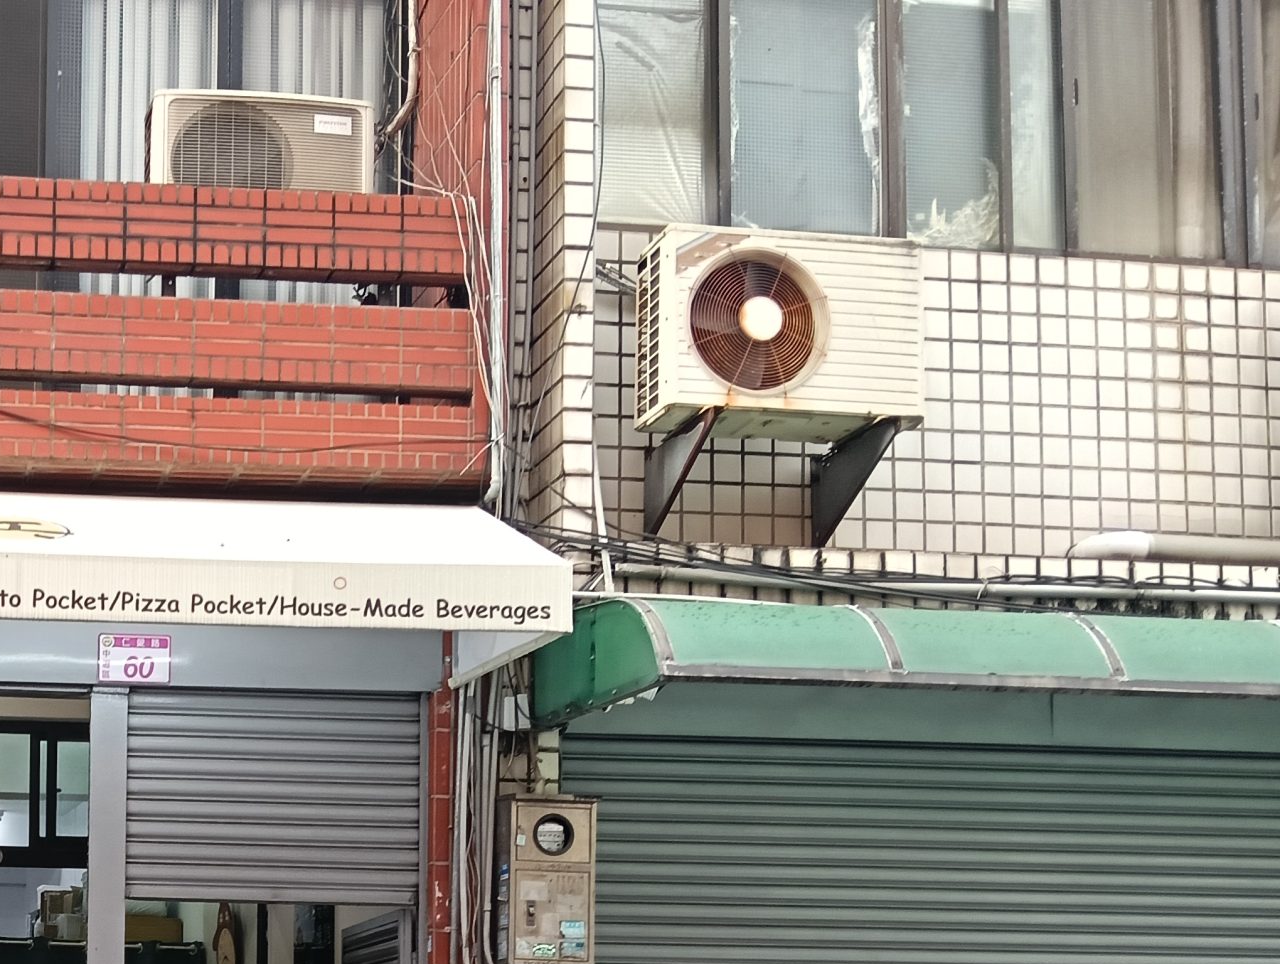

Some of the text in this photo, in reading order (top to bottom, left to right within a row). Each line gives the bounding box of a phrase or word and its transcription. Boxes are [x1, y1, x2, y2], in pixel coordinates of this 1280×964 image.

[32, 588, 181, 616] Pocket/Pizza
[437, 598, 552, 626] Beverages
[123, 655, 155, 679] 60
